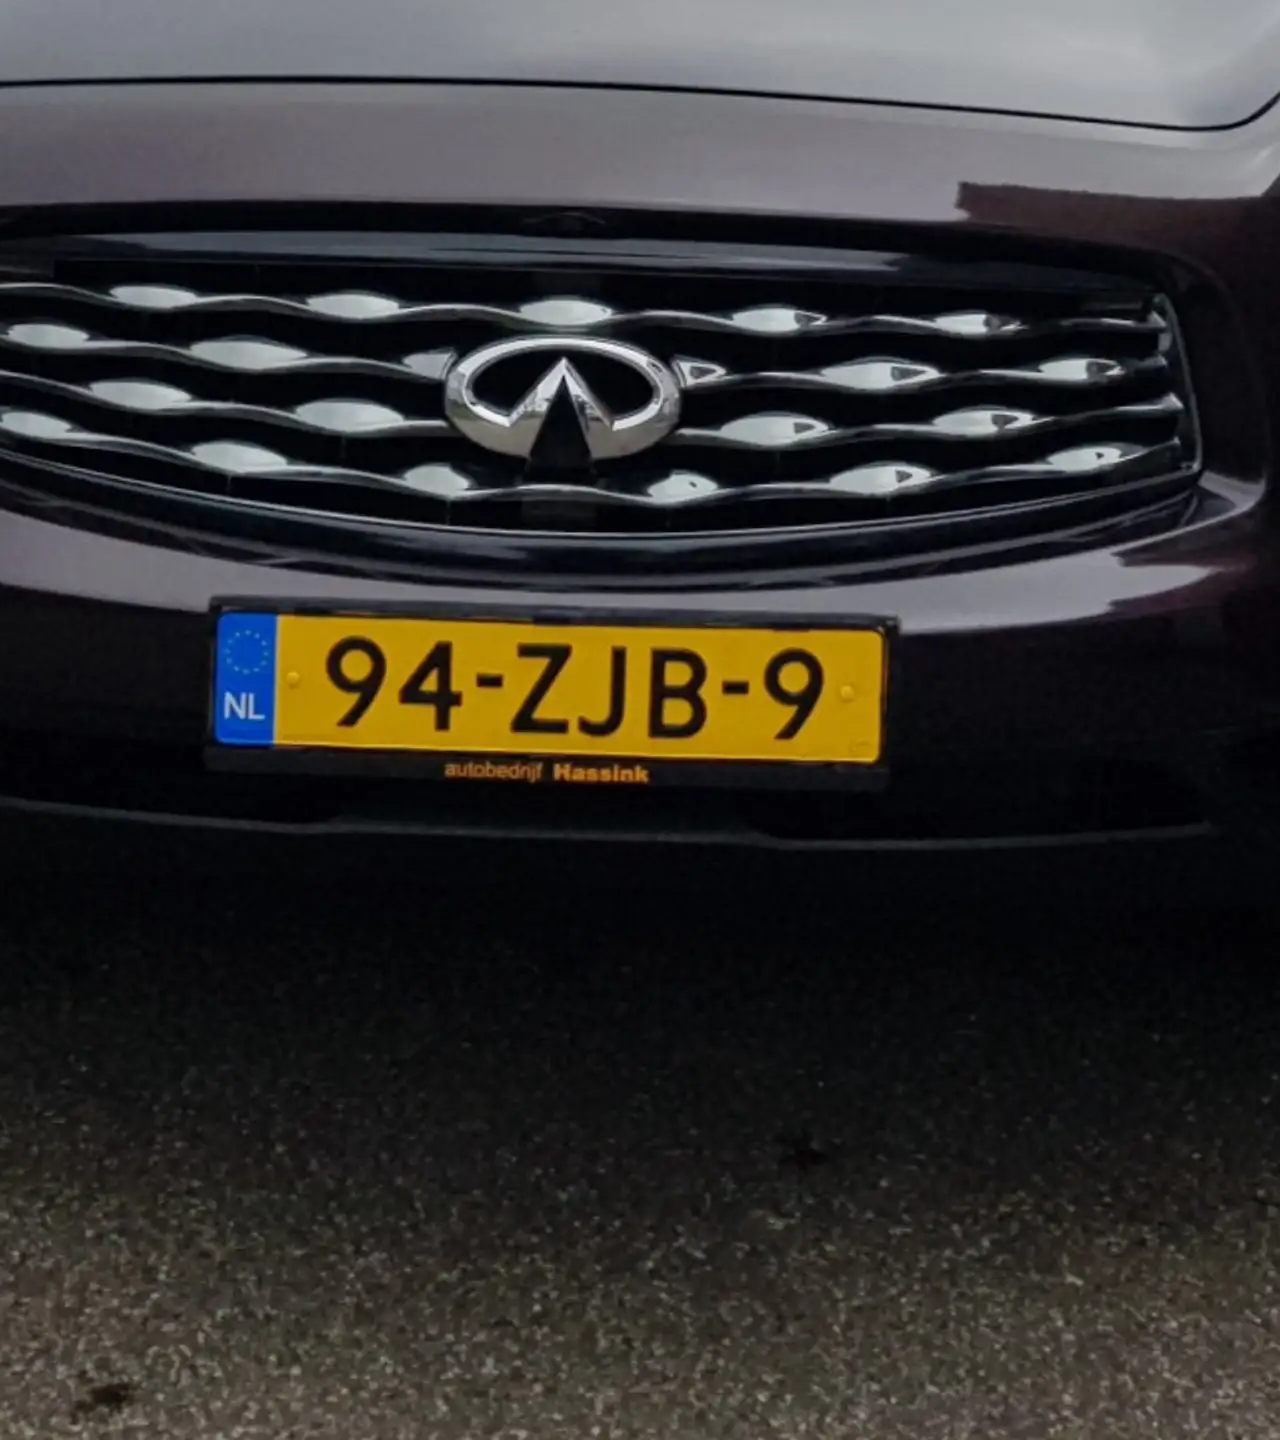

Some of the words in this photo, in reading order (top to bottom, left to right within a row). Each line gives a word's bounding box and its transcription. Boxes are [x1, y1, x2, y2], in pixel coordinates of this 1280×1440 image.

[324, 636, 825, 741] 94-ZJB-9
[222, 691, 266, 721] NL
[444, 762, 544, 783] autobedrijf
[553, 763, 650, 783] Hassink
